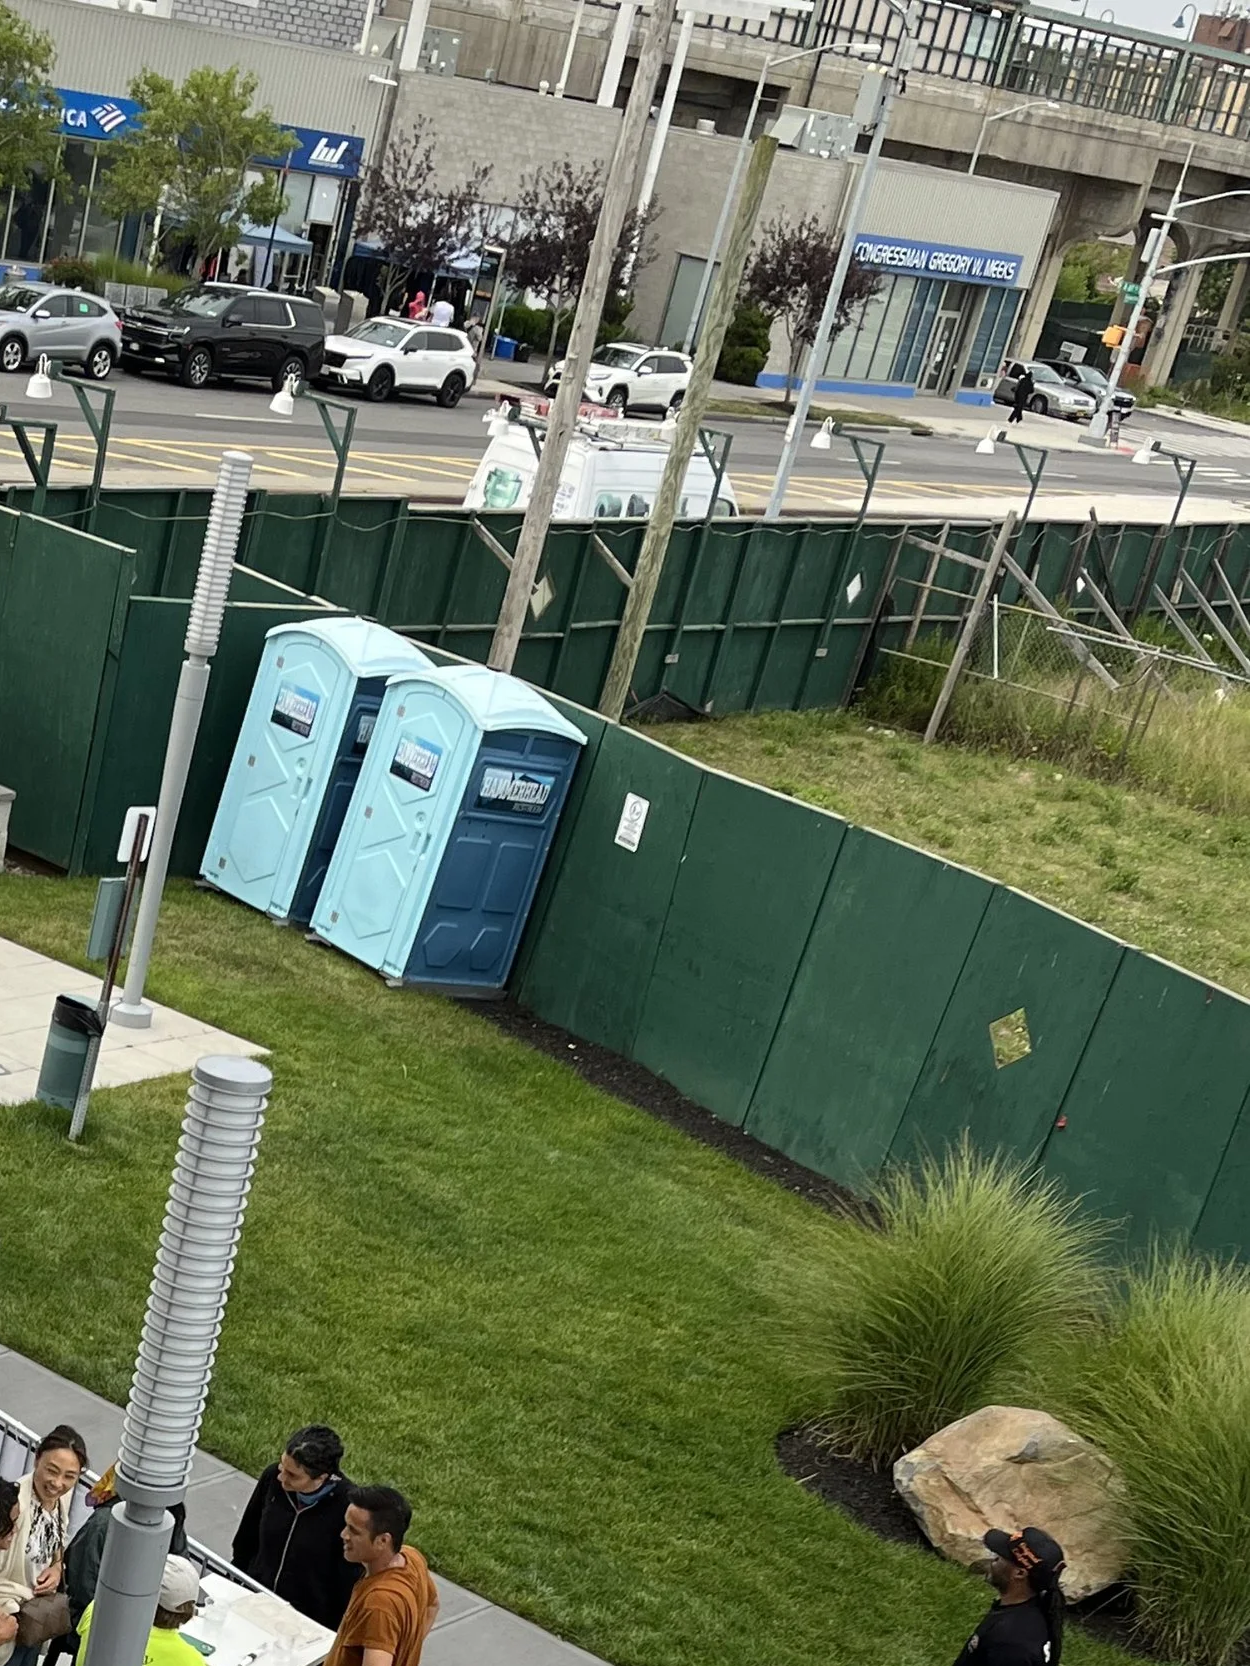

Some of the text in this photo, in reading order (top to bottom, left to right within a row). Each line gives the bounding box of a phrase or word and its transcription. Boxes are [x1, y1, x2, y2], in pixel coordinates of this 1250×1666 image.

[855, 241, 930, 270] CONGRESSMAN
[928, 251, 974, 275] GREGORY
[982, 259, 1017, 281] MEEKS
[480, 776, 551, 805] HAMMERHEAD
